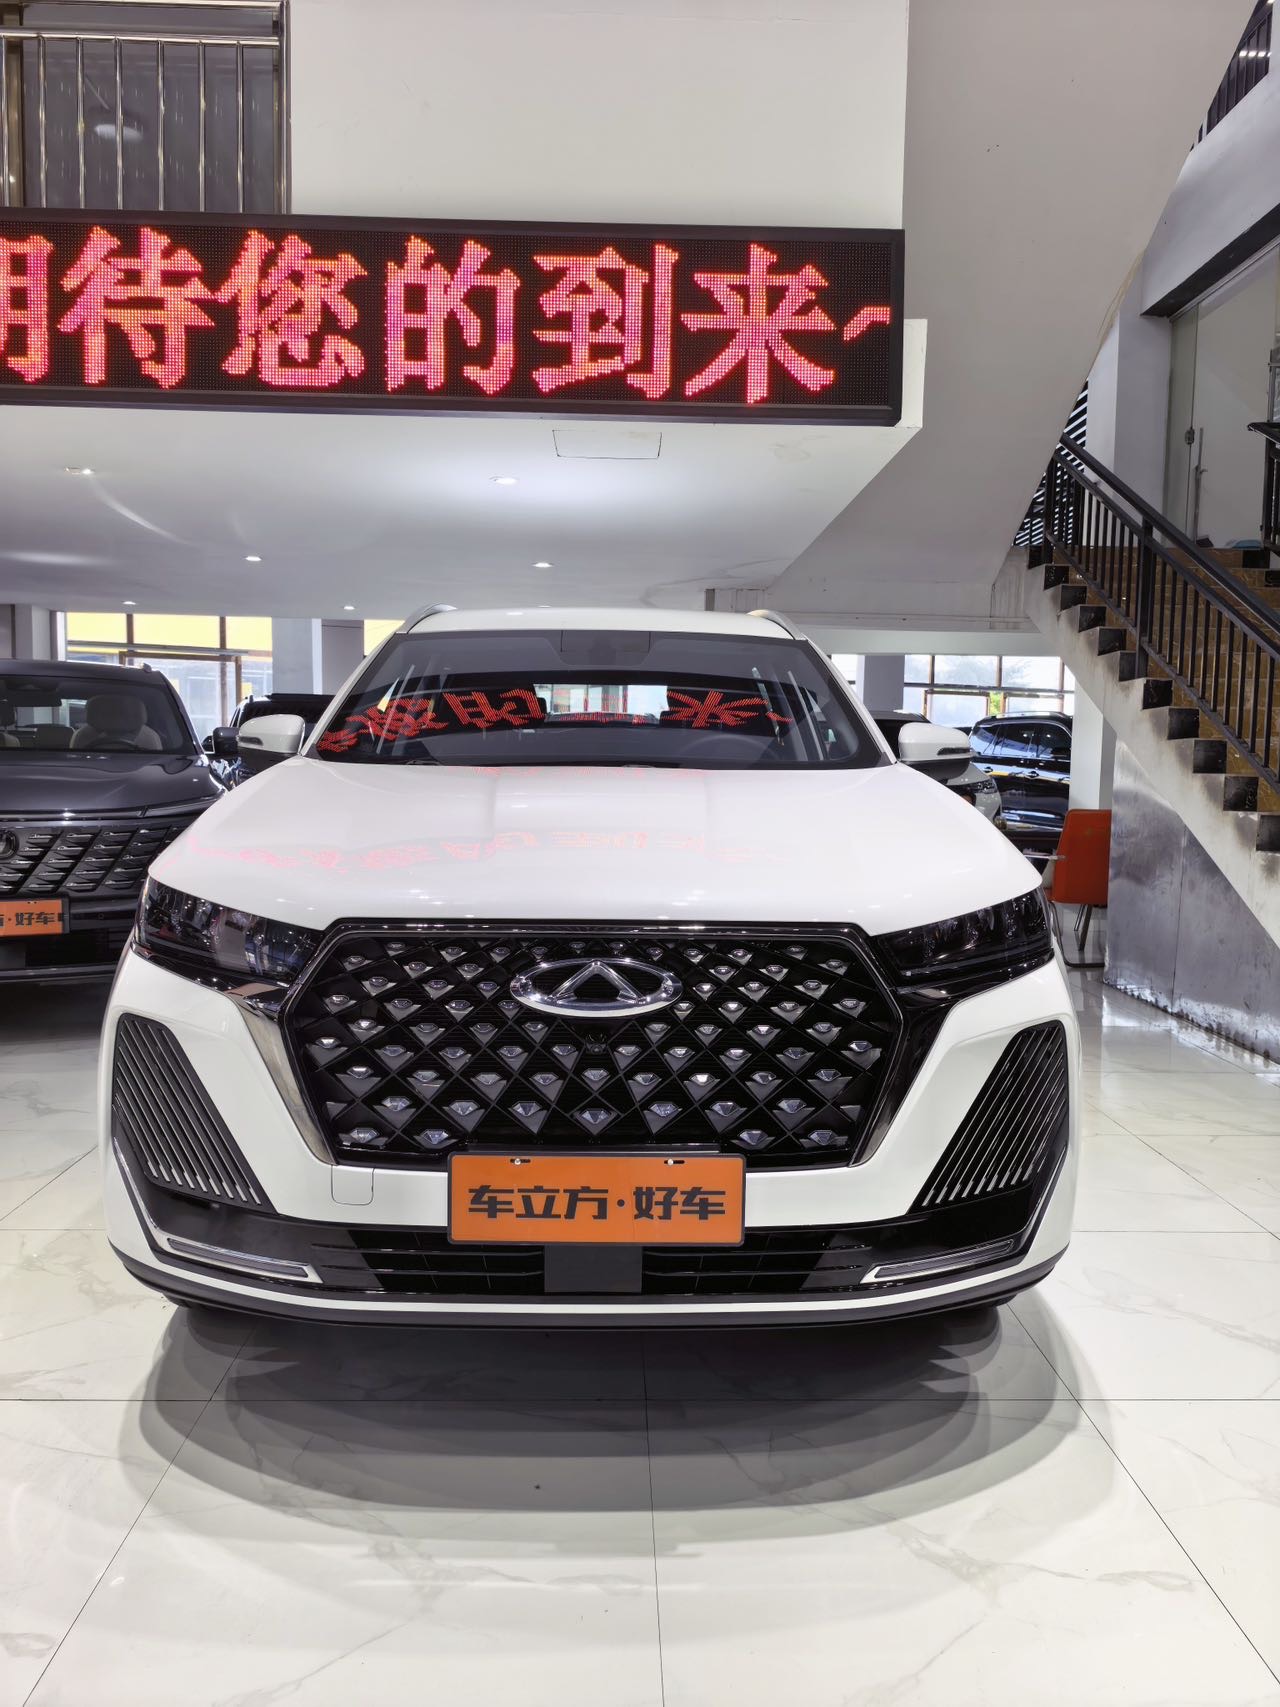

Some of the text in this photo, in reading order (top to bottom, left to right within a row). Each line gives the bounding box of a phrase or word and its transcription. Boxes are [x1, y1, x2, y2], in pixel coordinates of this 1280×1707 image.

[0, 911, 56, 927] ·好车
[468, 1184, 726, 1220] 车立方·好车
